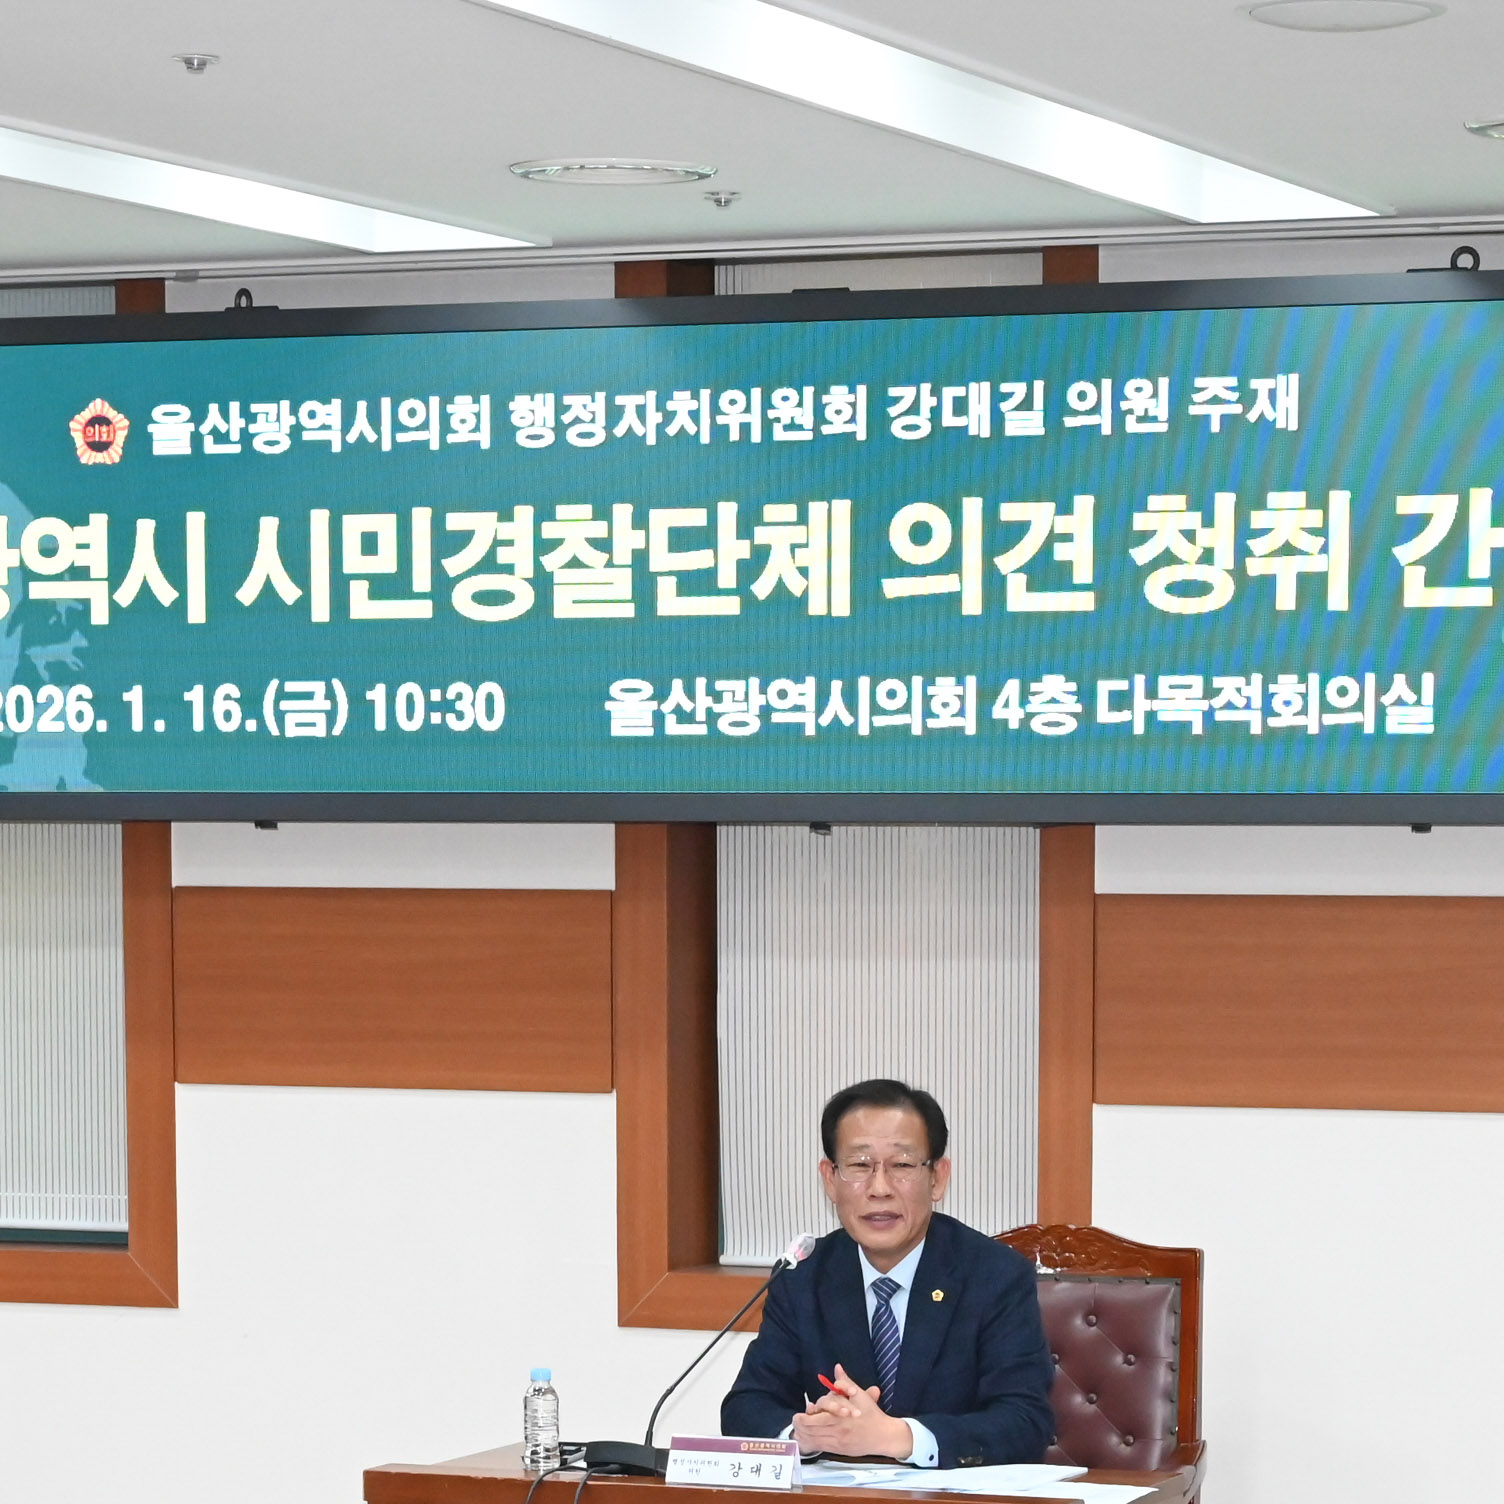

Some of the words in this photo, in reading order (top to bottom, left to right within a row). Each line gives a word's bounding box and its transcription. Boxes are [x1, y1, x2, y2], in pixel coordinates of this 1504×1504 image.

[148, 395, 492, 457] 울산광역시의회
[509, 385, 868, 450] 행정자치위원회
[887, 380, 1046, 441] 강대길
[1063, 378, 1171, 437] 의원
[1188, 374, 1301, 434] 주재
[235, 499, 853, 624] 시민경찰단체
[882, 494, 1096, 617] 의견
[1128, 490, 1352, 616] 청취
[123, 685, 166, 733] 1.
[183, 678, 350, 740] 16.(금)
[365, 681, 507, 733] 10:30
[604, 676, 979, 739] 울산광역시의회
[992, 675, 1085, 738] 4층
[1096, 672, 1437, 736] 다목적회의실
